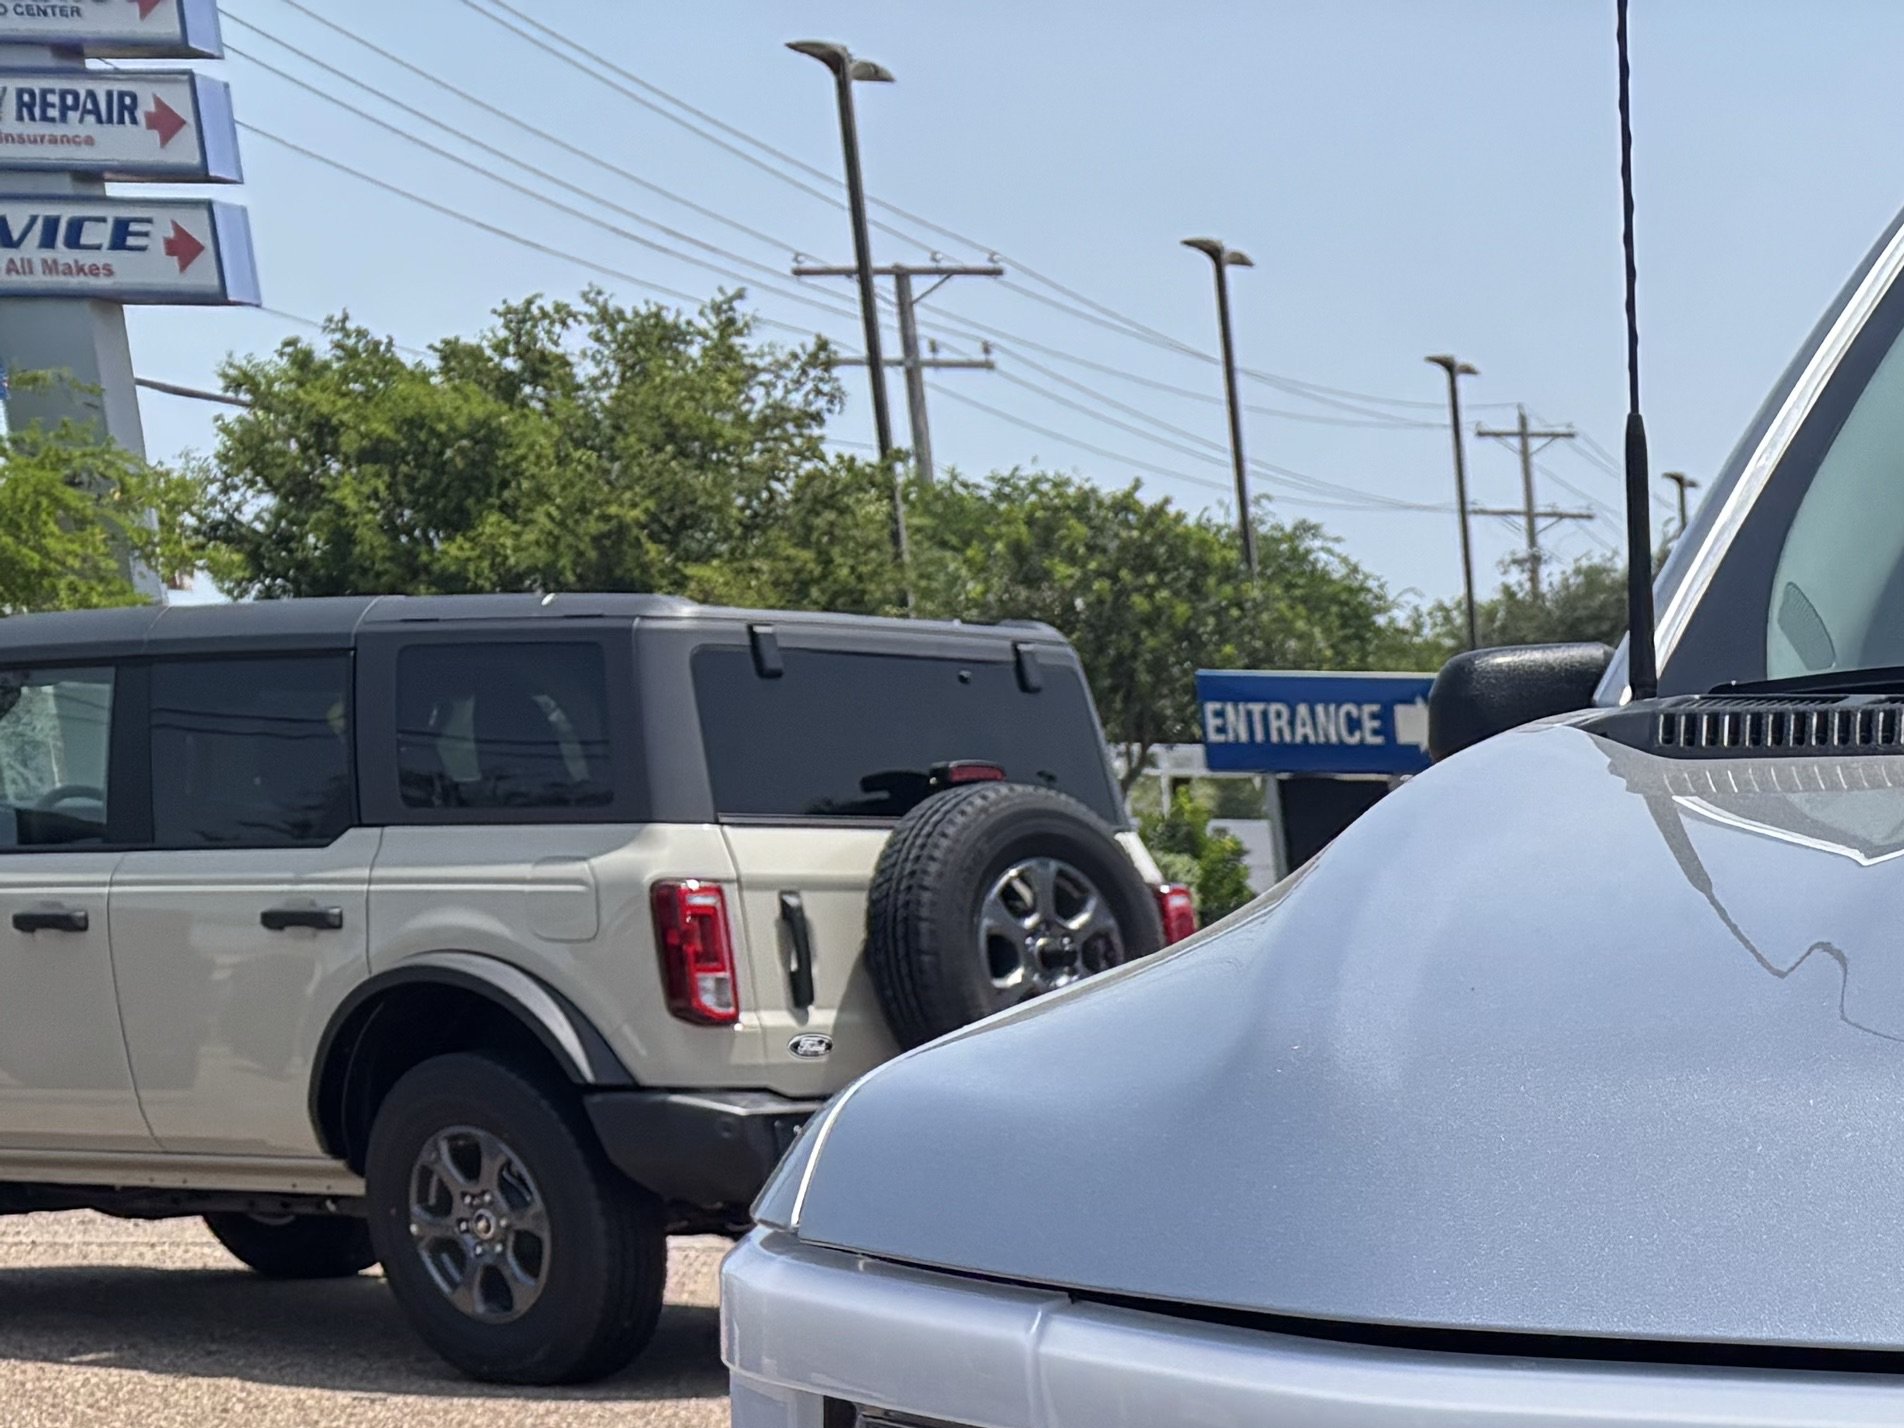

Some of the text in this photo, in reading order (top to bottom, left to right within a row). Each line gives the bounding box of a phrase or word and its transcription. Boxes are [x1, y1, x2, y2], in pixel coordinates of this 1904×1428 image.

[13, 3, 82, 18] CENTER
[15, 87, 139, 125] REPAIR
[5, 257, 115, 277] All Makes
[1202, 701, 1386, 746] ENTRANCE
